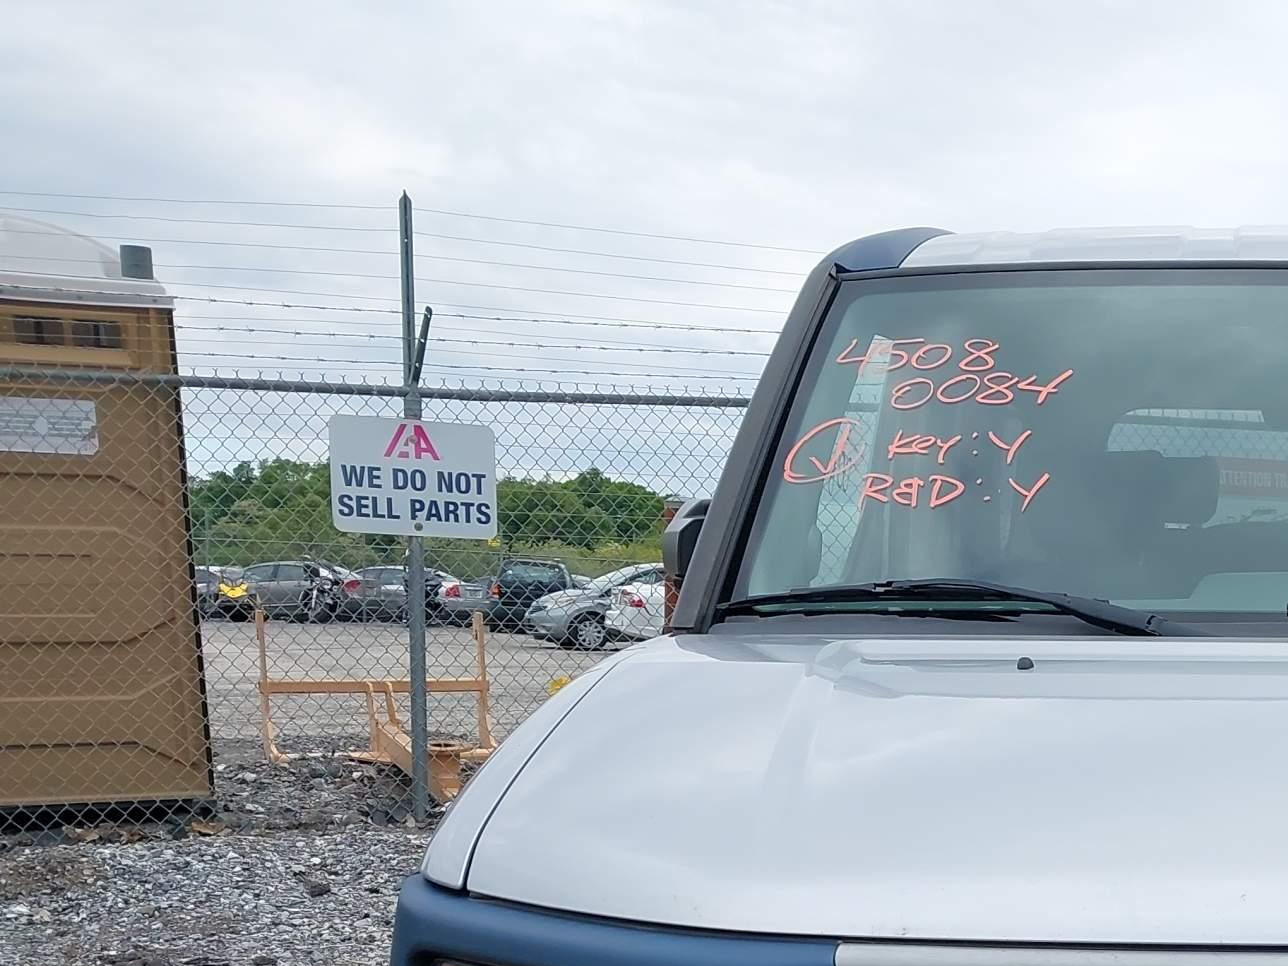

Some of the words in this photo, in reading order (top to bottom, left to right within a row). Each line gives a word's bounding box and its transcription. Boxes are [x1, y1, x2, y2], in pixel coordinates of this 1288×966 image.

[836, 338, 999, 377] 4508
[890, 369, 1073, 409] 0084
[340, 464, 383, 489] WE
[392, 467, 427, 492] DO
[437, 470, 487, 495] NOT
[337, 494, 401, 520] SELL
[409, 498, 492, 525] PARTS
